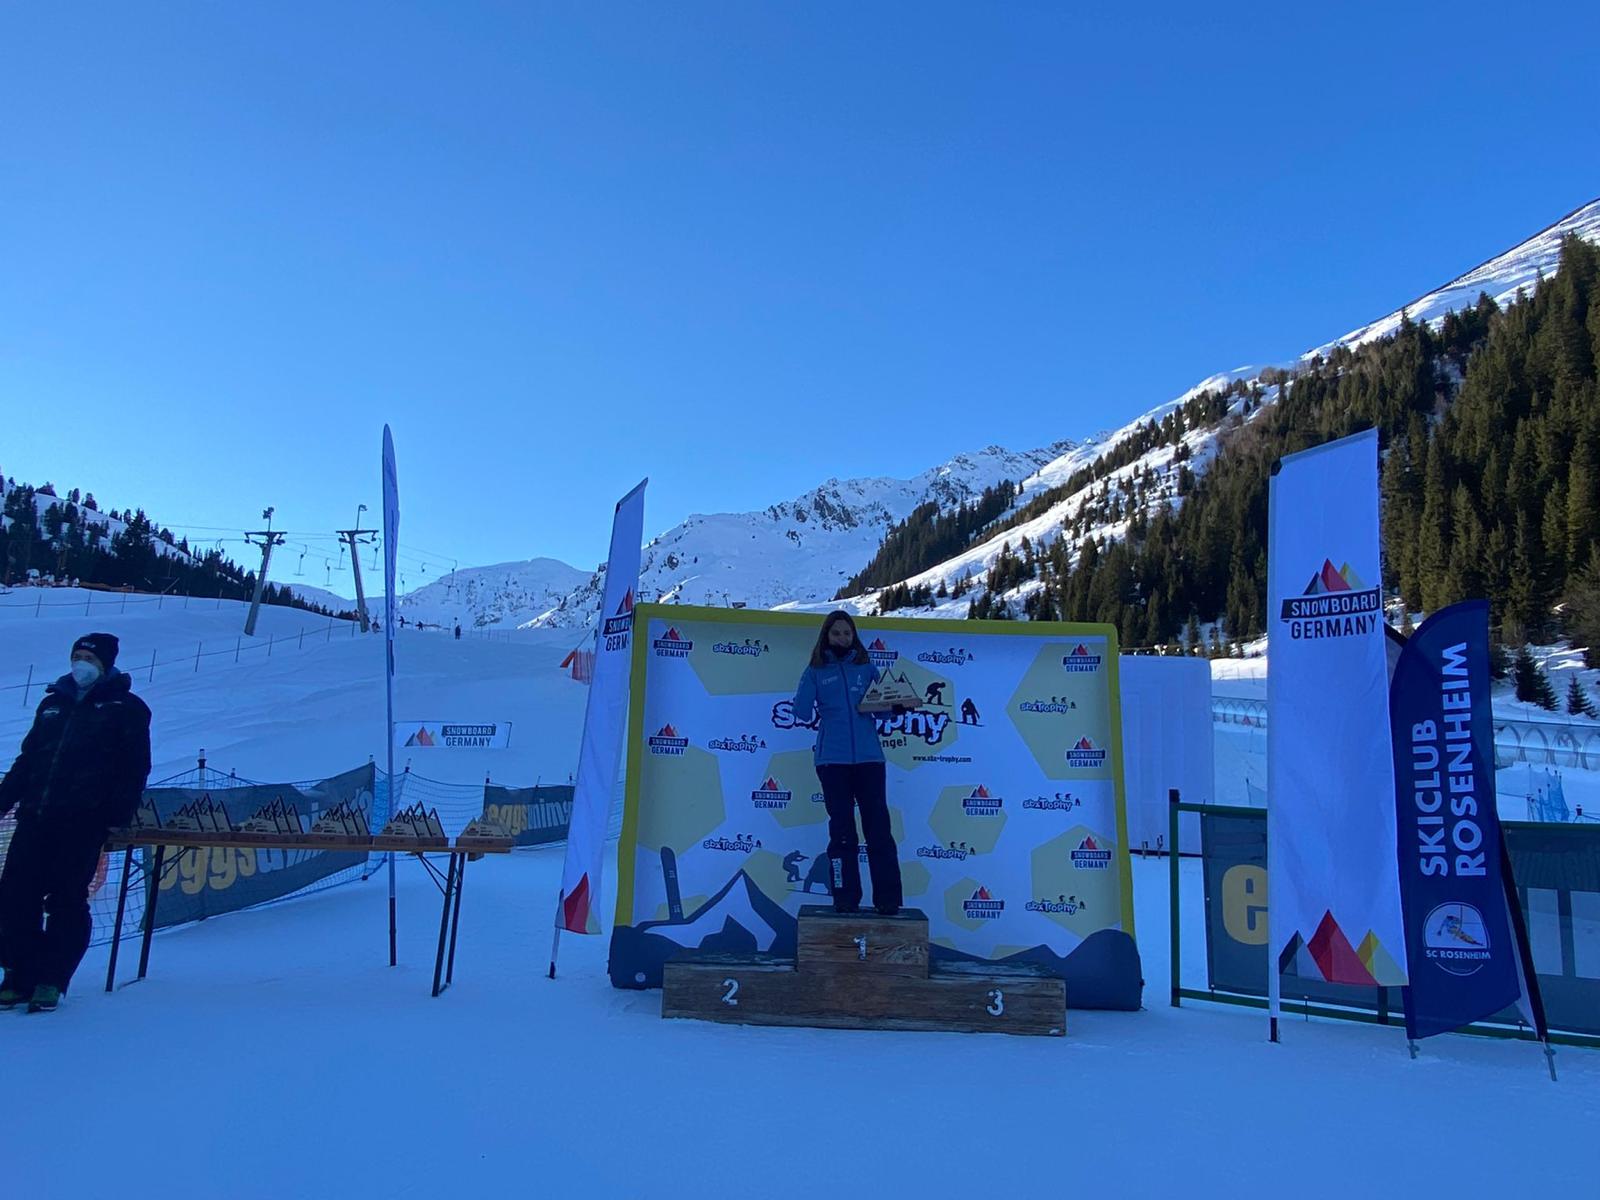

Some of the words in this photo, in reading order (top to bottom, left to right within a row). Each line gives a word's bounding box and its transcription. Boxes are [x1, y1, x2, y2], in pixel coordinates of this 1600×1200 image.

[1290, 593, 1377, 617] SNOWBOARD
[1290, 614, 1377, 640] GERMANY
[656, 649, 689, 658] GERMANY
[1066, 664, 1098, 672] GERMANY
[446, 727, 492, 735] SNOWBOARD
[445, 736, 491, 747] GERMANY
[651, 746, 685, 755] GERMANY
[1069, 759, 1103, 767] GERMANY
[1441, 641, 1487, 877] ROSENHEIM
[1411, 719, 1449, 877] SKICLUB
[754, 800, 788, 809] GERMANY
[965, 807, 999, 816] GERMANY
[1074, 860, 1108, 869] GERMANY
[966, 910, 1001, 919] GERMANY
[854, 936, 867, 961] 1
[1425, 950, 1438, 958] SC
[1439, 950, 1491, 960] ROSENHEIM
[720, 977, 740, 1006] 2
[985, 988, 1004, 1017] 3
